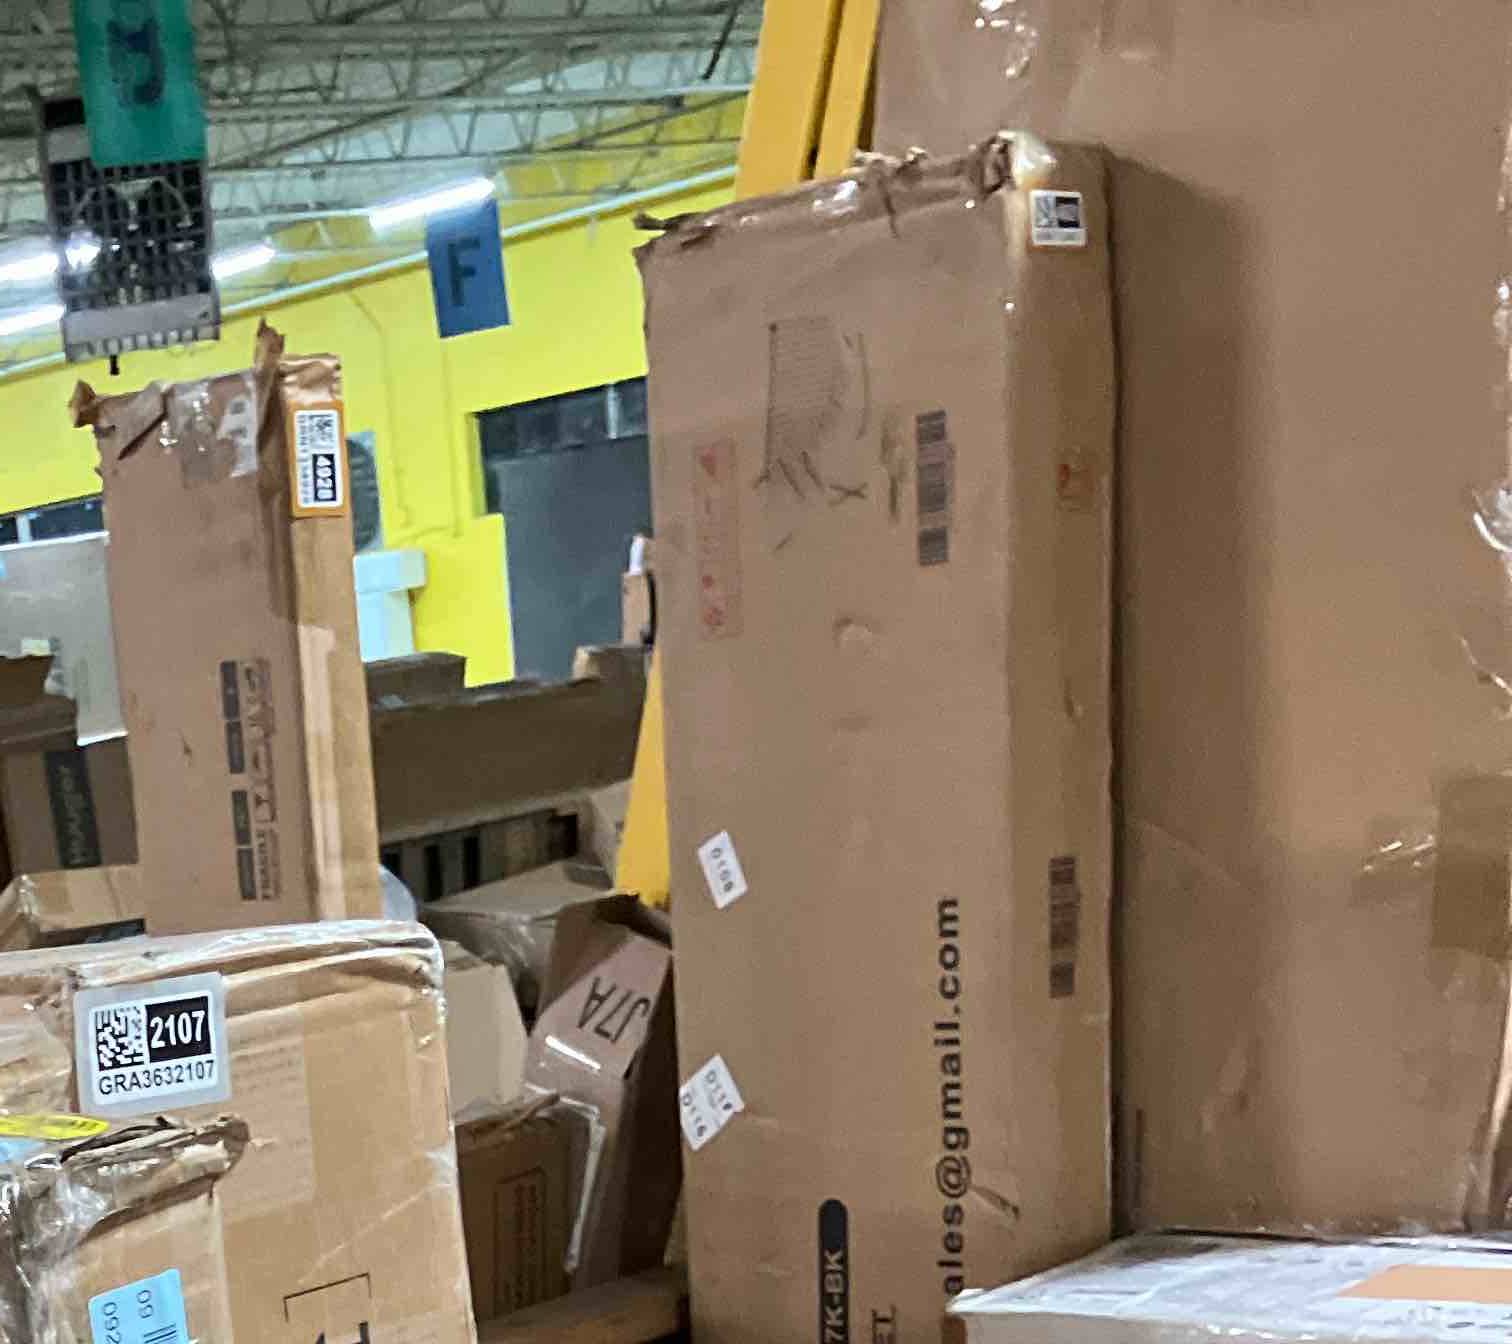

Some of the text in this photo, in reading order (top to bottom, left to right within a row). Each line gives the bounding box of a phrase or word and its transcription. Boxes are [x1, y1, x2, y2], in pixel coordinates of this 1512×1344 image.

[447, 236, 481, 307] F
[149, 1008, 209, 1050] 2107
[97, 1057, 216, 1097] GRA3632107
[934, 896, 970, 1297] ales@gmail.com
[136, 1287, 154, 1320] 09
